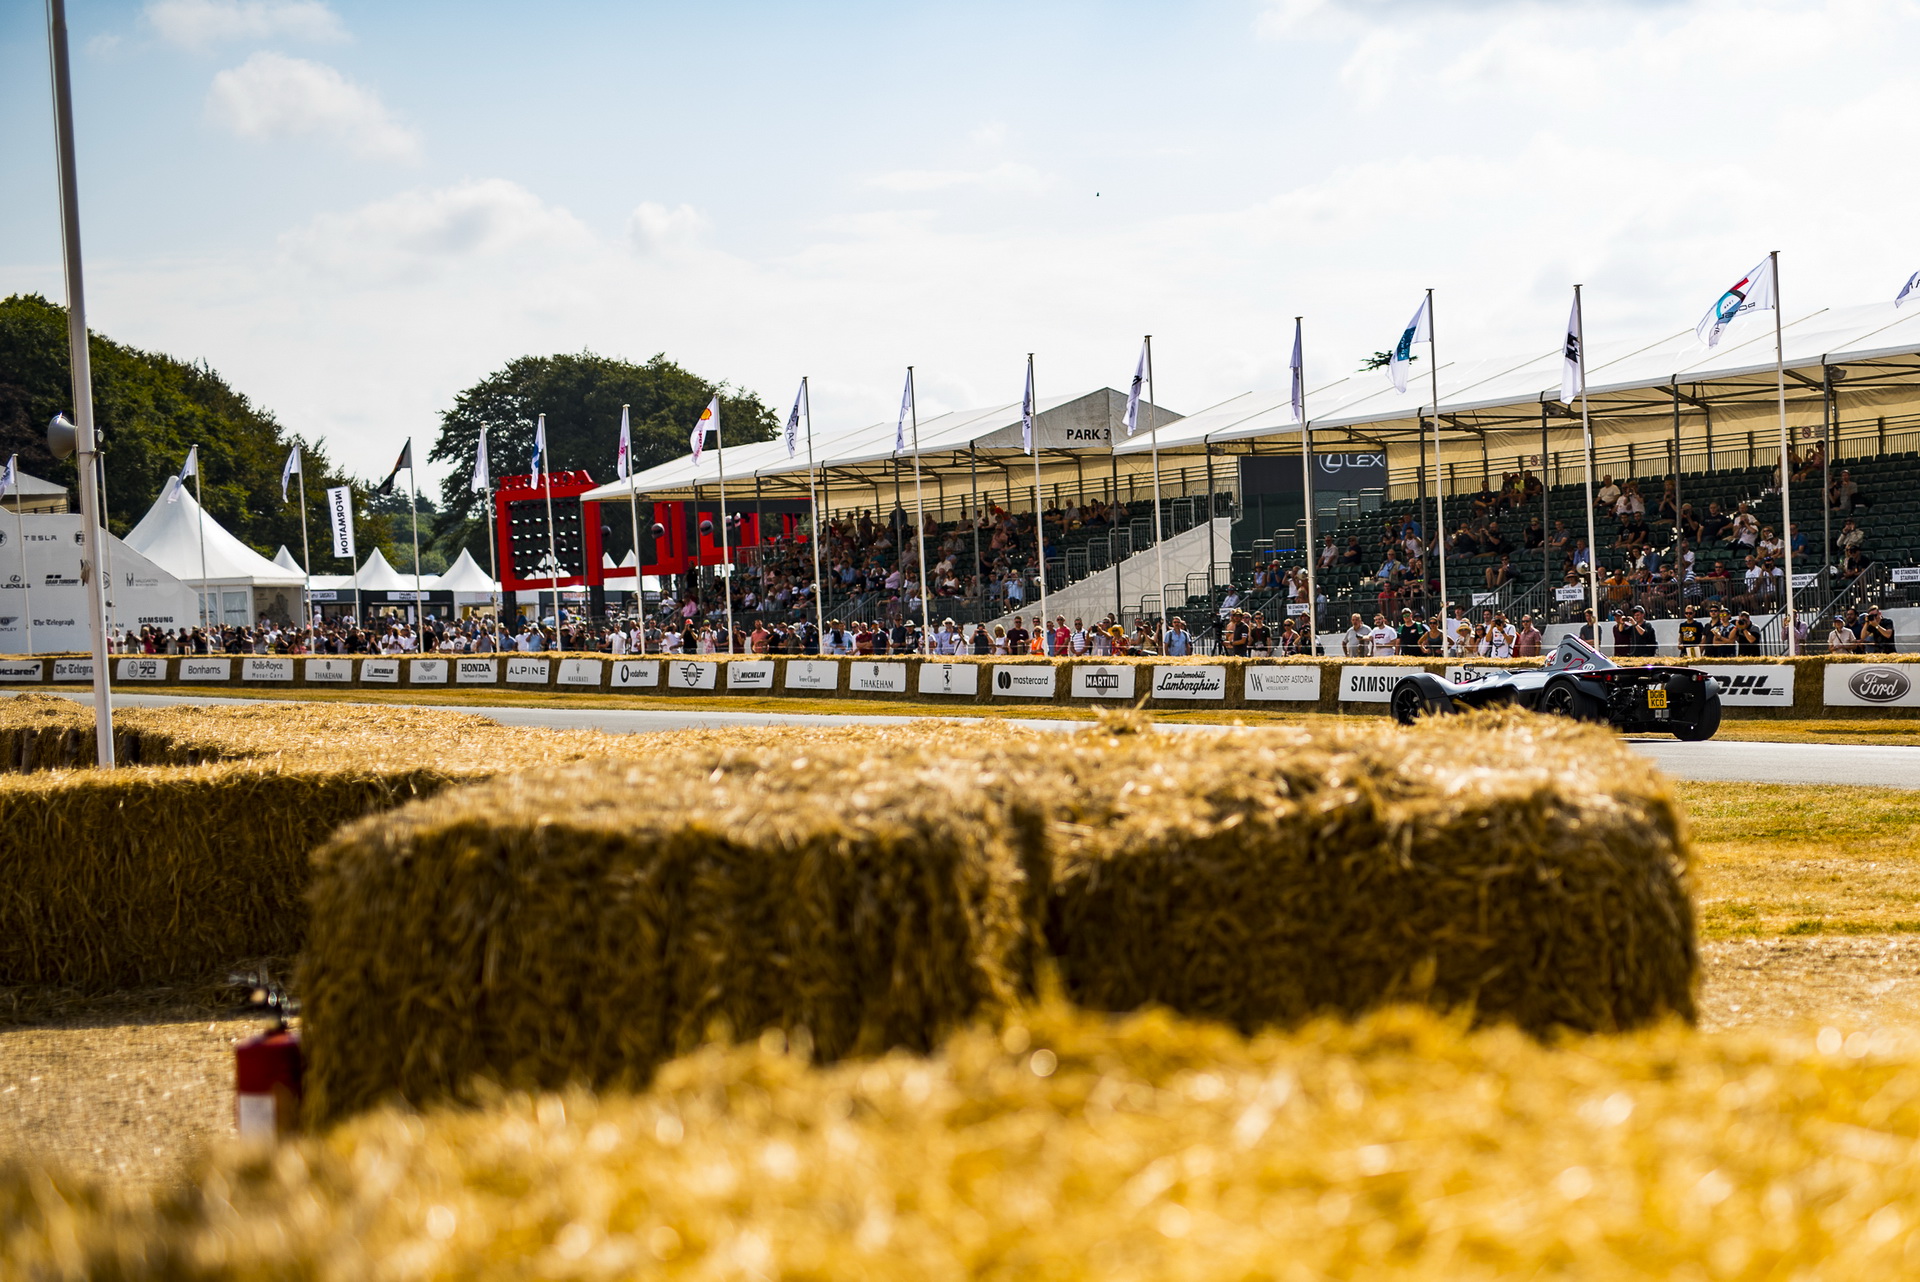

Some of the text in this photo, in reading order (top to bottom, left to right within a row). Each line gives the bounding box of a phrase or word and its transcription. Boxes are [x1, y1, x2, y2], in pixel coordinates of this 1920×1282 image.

[1066, 428, 1101, 440] PARK
[1345, 454, 1386, 468] LEX
[138, 616, 174, 624] SAMSUNG
[55, 664, 94, 676] The Telegra
[139, 666, 157, 675] 70
[188, 665, 221, 675] Bonhams
[252, 660, 283, 671] Rolls-Royce
[461, 663, 491, 673] HONDA
[509, 666, 546, 676] ALPINE
[630, 670, 649, 678] vodafone
[741, 671, 766, 679] MICHELIN
[1173, 671, 1207, 679] automobili
[860, 679, 894, 689] THAKEHAM
[1013, 674, 1049, 685] mastercard
[1086, 676, 1118, 687] MARTINI
[1157, 672, 1220, 695] Lamborghini
[1265, 675, 1290, 684] WALDORF
[1351, 675, 1402, 692] SAMSU
[1859, 672, 1899, 697] Ford
[1711, 675, 1772, 695] DHL
